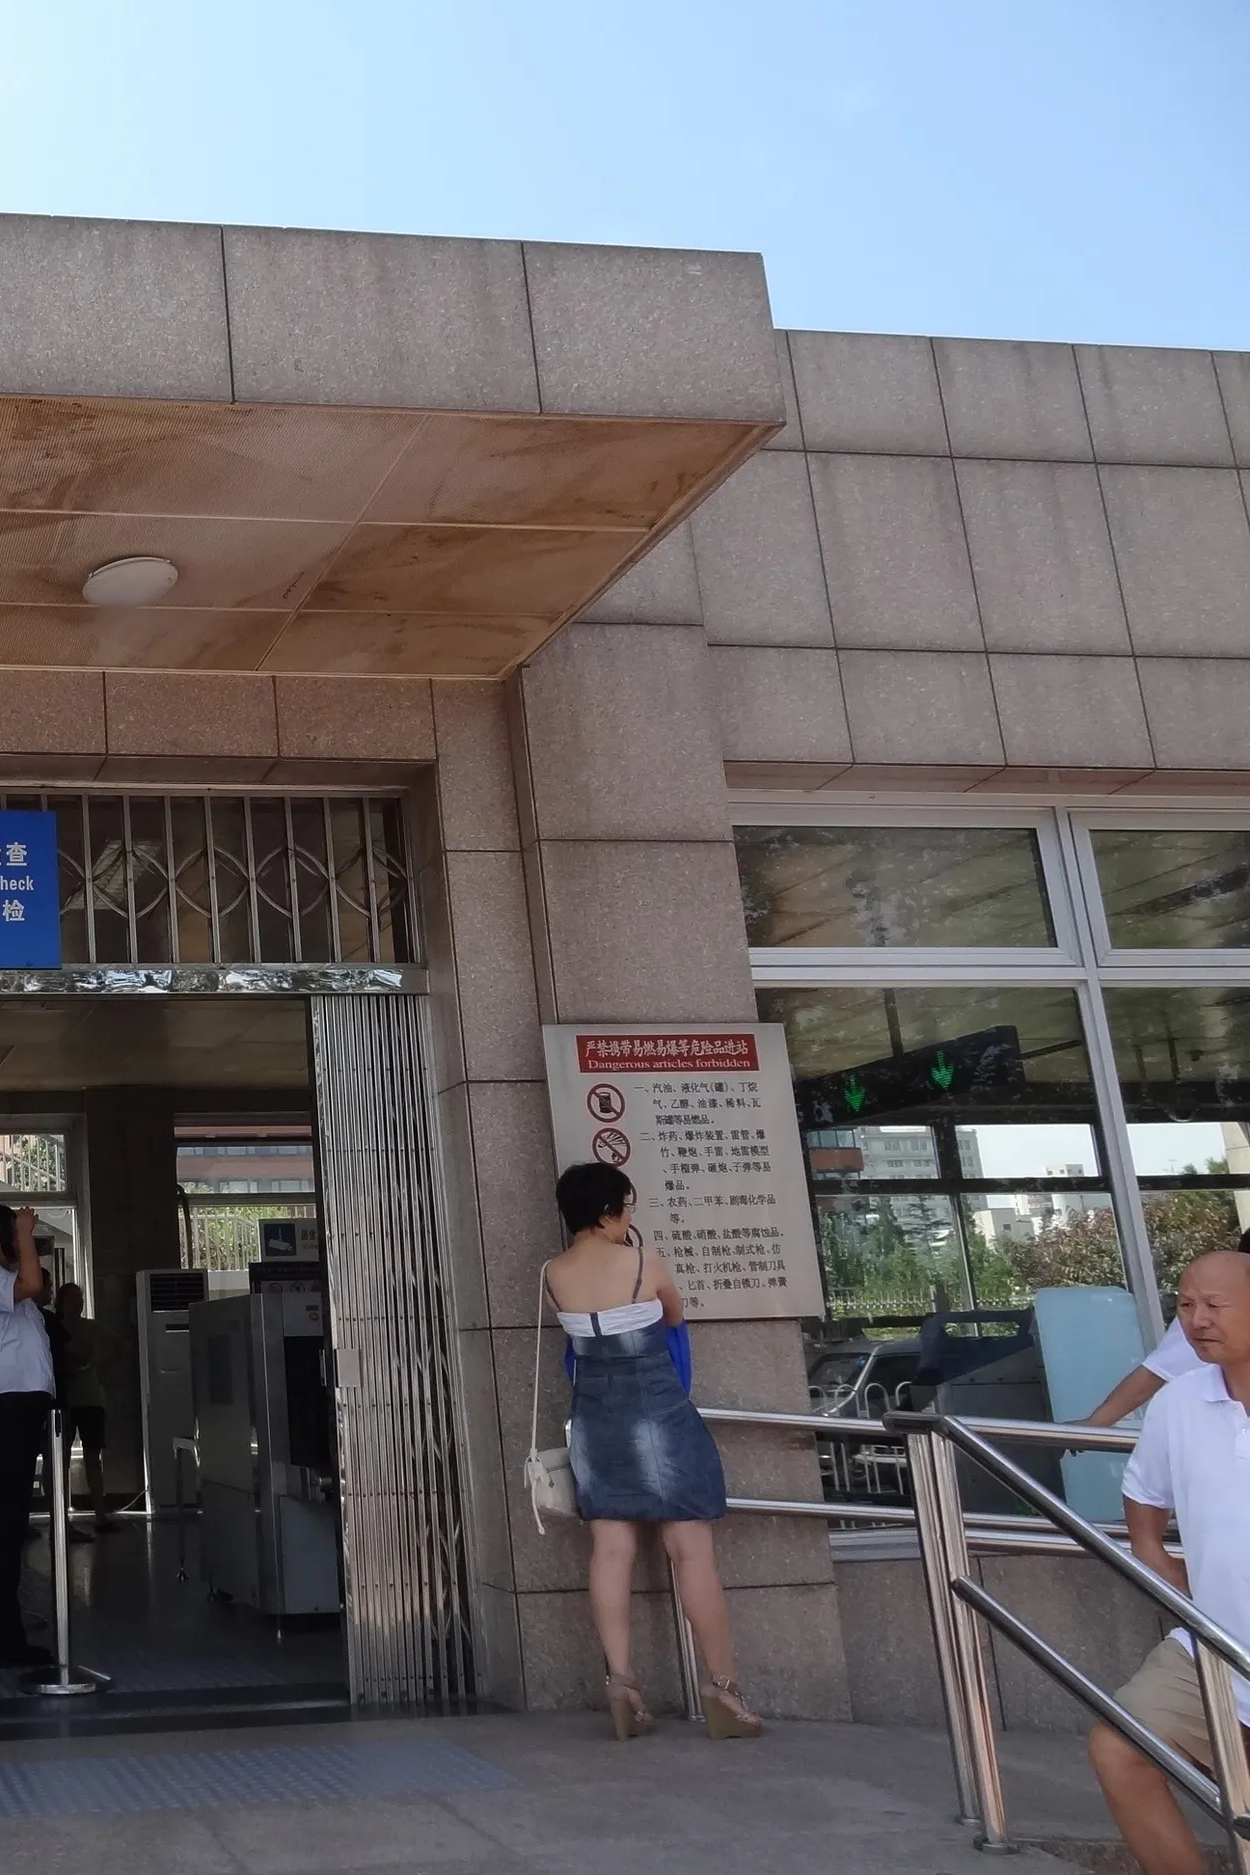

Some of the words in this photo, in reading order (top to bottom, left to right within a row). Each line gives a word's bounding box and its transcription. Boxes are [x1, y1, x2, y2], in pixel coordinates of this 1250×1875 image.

[585, 1038, 748, 1058] 严禁携带易燃易爆等危险品进站
[587, 1059, 651, 1071] Dangerous
[652, 1059, 693, 1069] articles
[695, 1058, 751, 1068] forbidden
